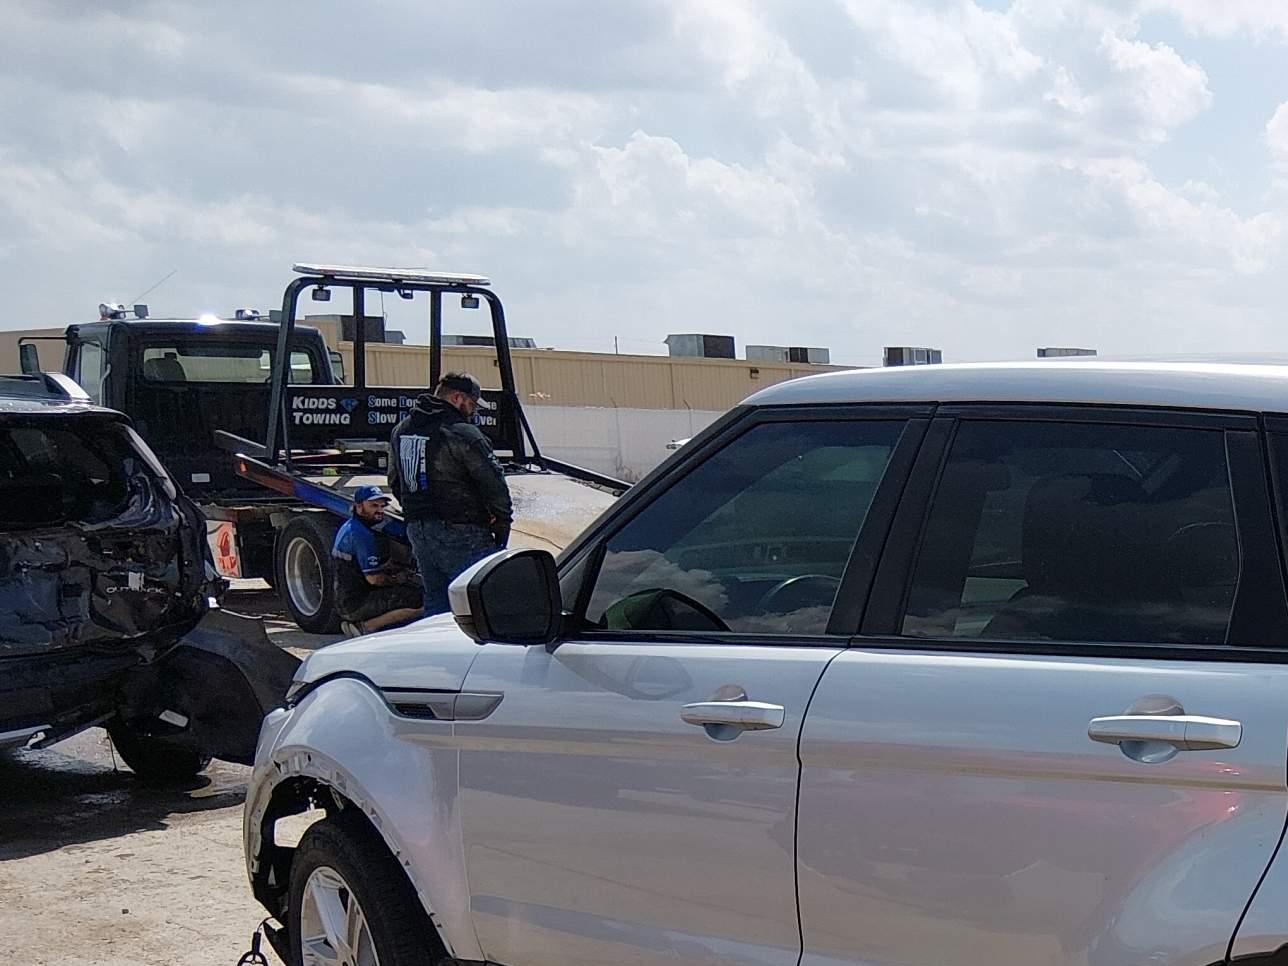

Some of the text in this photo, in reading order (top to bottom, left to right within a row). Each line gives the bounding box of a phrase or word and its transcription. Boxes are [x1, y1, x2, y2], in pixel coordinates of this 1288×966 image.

[292, 396, 337, 409] KIDDS
[367, 395, 397, 407] Some
[293, 412, 351, 424] TOWING
[367, 411, 397, 424] Slow
